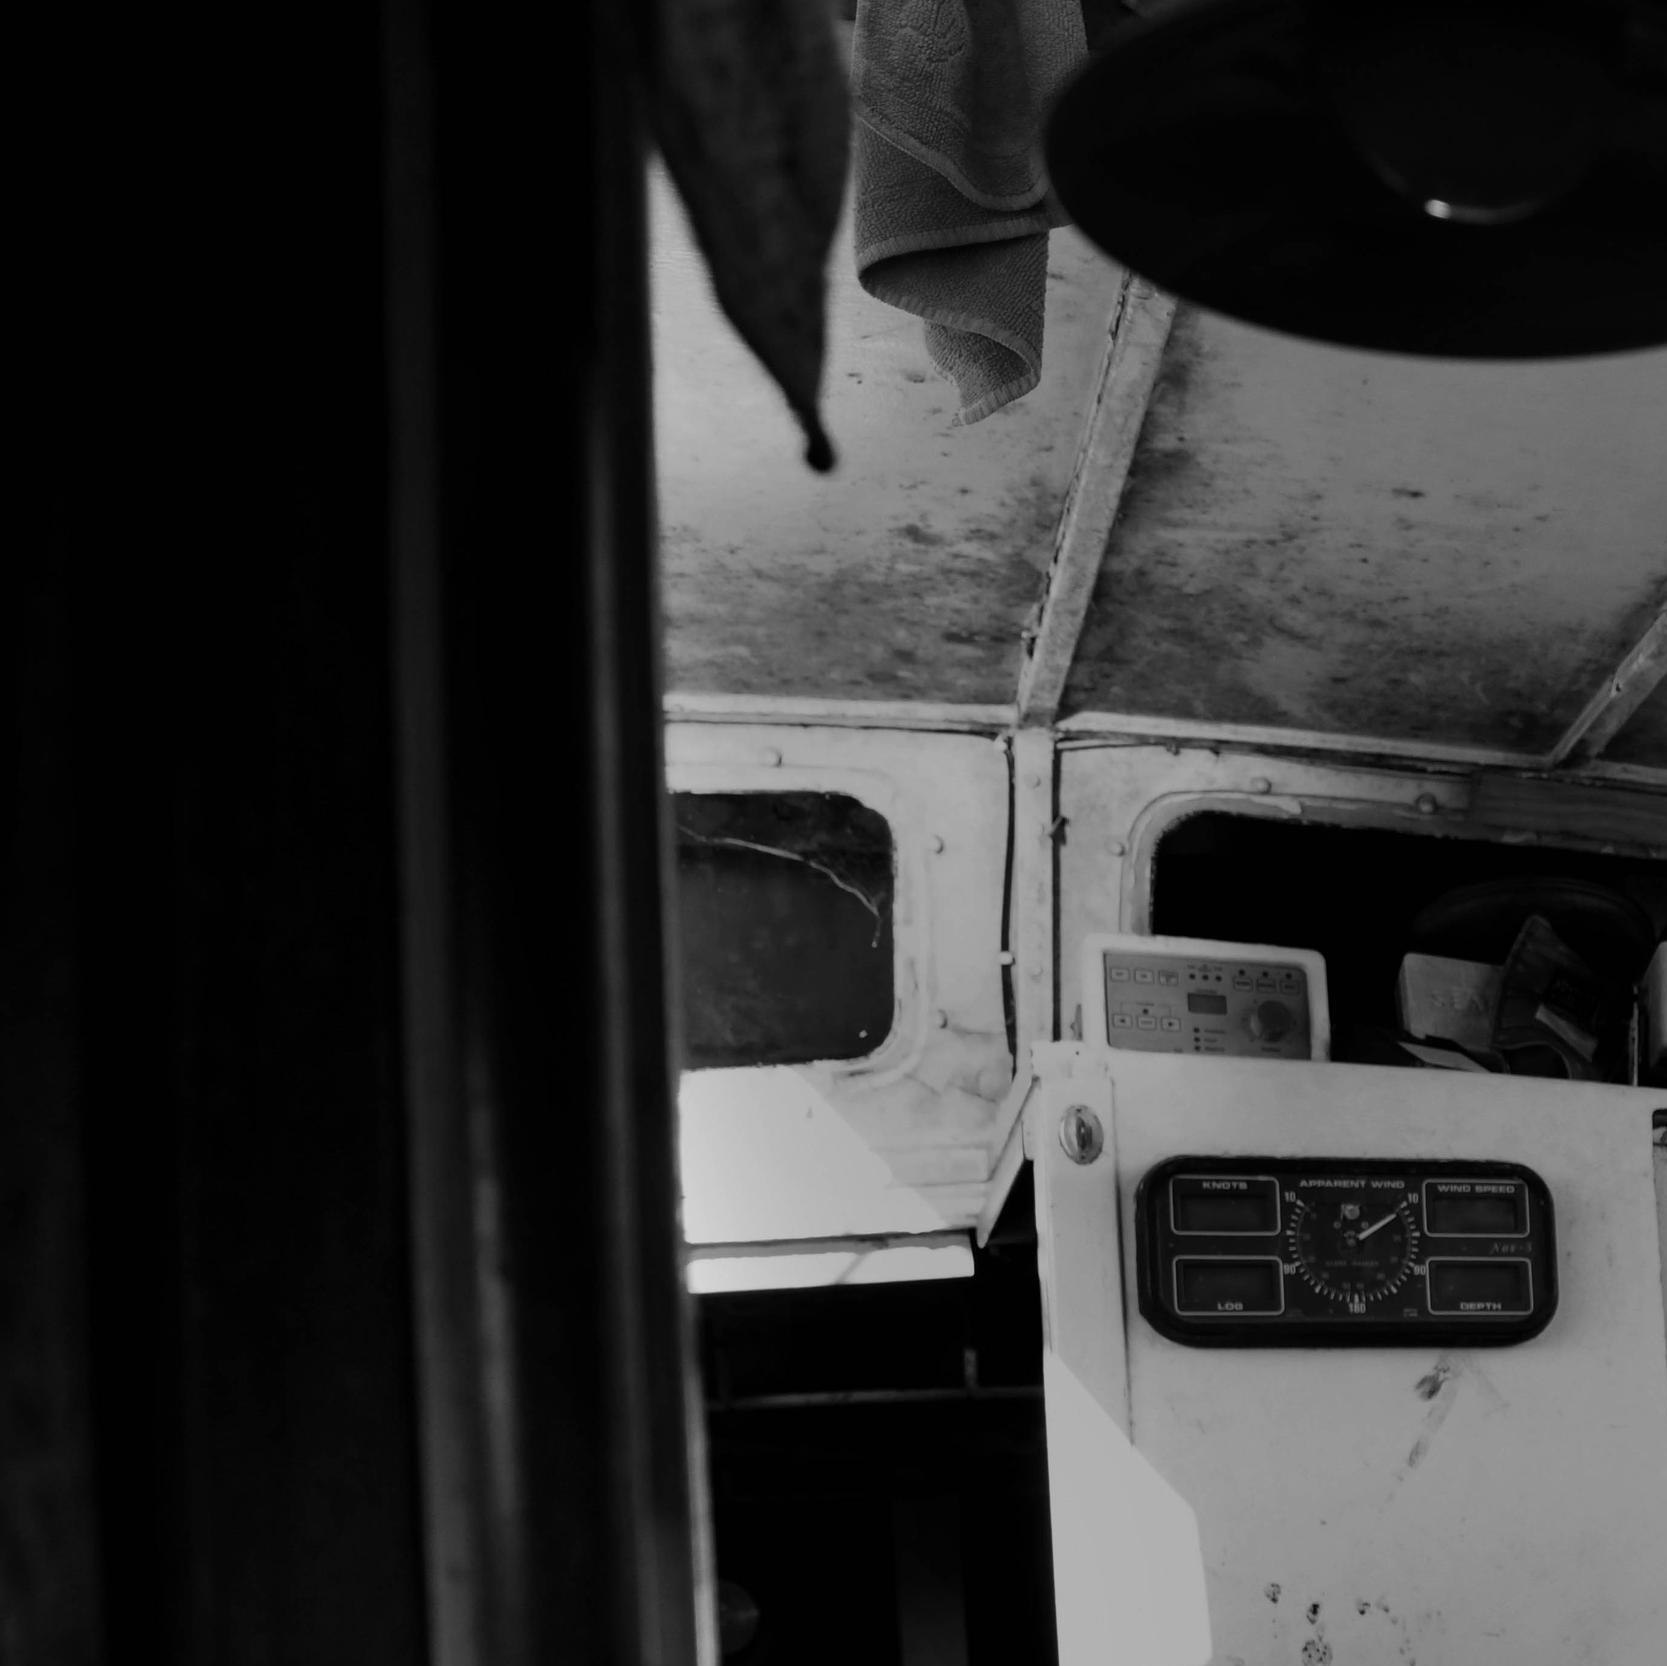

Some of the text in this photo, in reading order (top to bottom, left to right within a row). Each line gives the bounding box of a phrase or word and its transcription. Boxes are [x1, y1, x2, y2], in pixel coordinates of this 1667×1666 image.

[1202, 1180, 1248, 1191] KNOTS
[1299, 1179, 1405, 1190] APPARENT WIND
[1437, 1184, 1515, 1194] WIND SPEED
[1284, 1191, 1296, 1203] 10
[1407, 1192, 1419, 1204] 10
[1283, 1263, 1297, 1276] 90
[1413, 1264, 1427, 1277] 90
[1217, 1301, 1244, 1311] LOG
[1459, 1301, 1502, 1312] DEPTH
